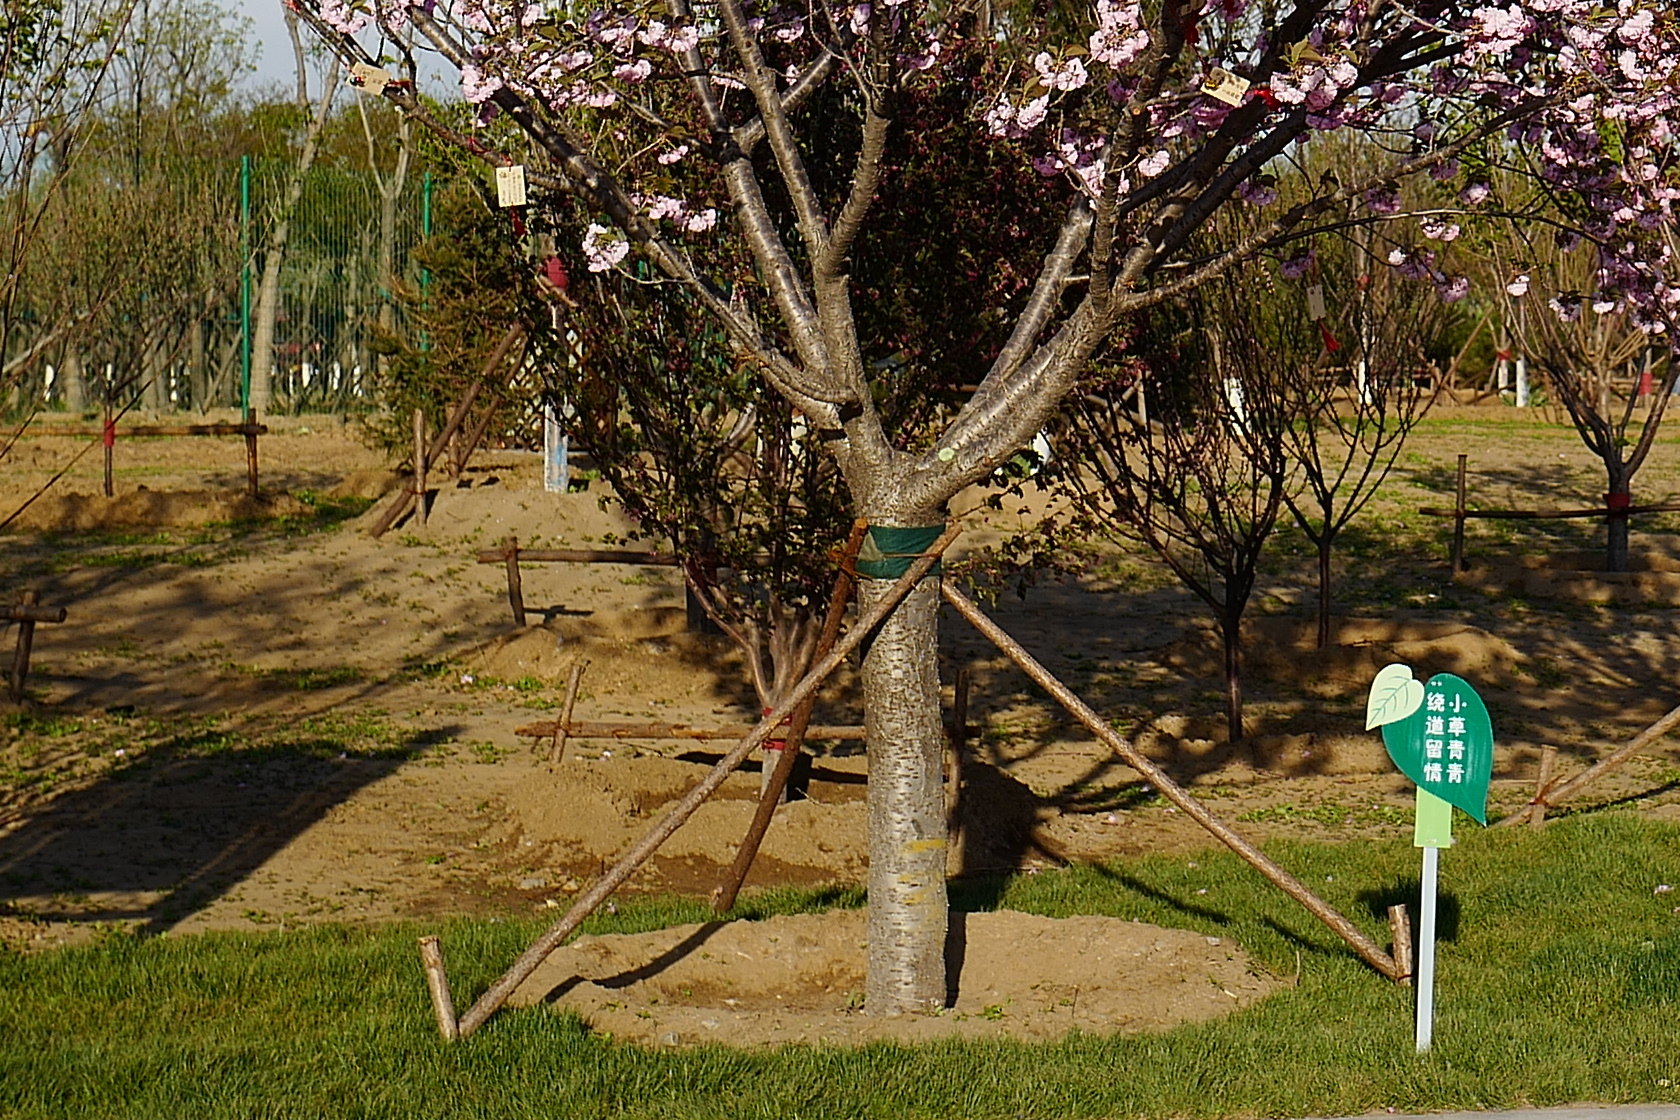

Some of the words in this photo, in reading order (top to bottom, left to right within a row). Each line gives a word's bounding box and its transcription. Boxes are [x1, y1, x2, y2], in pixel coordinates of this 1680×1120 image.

[1424, 692, 1445, 782] 绕道留情
[1446, 693, 1467, 783] 小草青青
